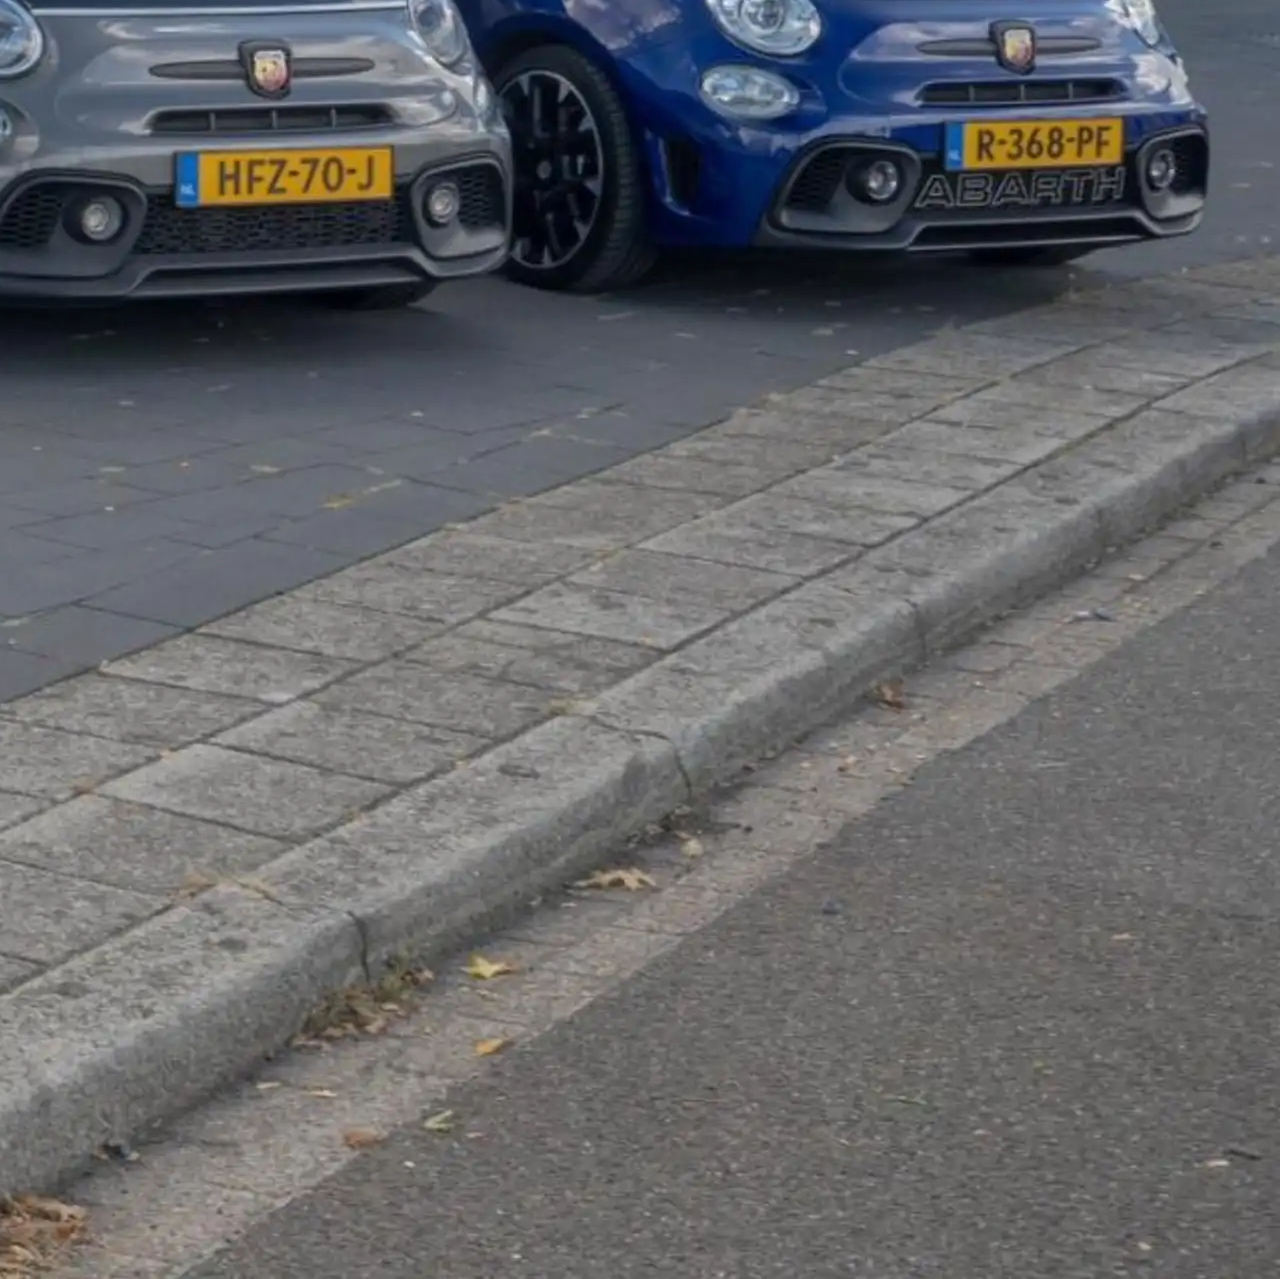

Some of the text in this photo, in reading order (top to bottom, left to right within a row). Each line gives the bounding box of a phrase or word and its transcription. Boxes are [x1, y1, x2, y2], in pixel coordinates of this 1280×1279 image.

[976, 124, 1114, 162] R-368-PF
[217, 153, 376, 197] HFZ-70-J
[915, 167, 1127, 208] ABARTH
